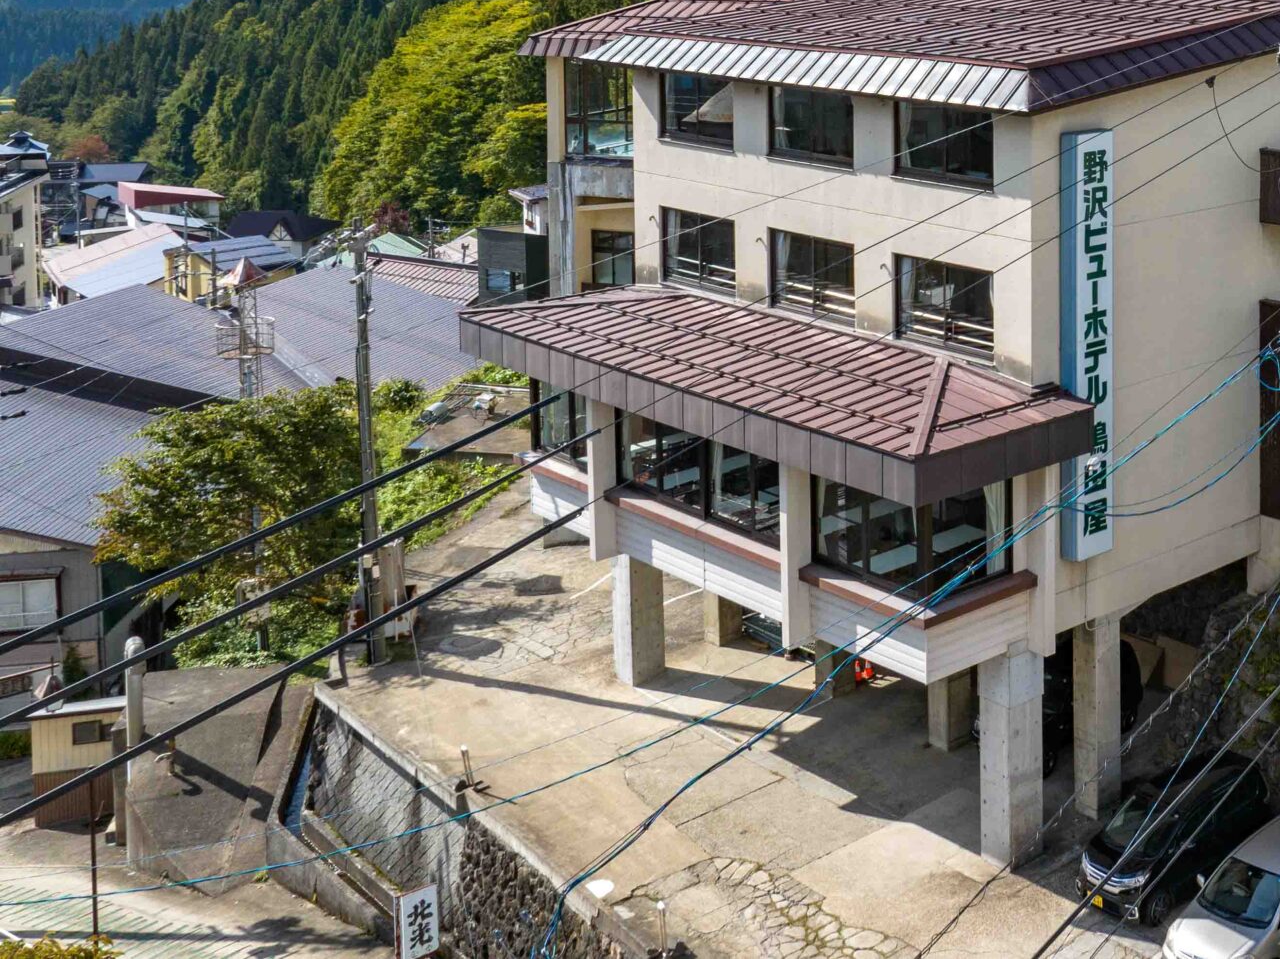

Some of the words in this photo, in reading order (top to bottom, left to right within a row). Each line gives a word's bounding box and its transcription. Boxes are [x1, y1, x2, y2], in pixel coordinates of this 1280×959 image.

[1083, 149, 1108, 406] 野沢ビューホテル
